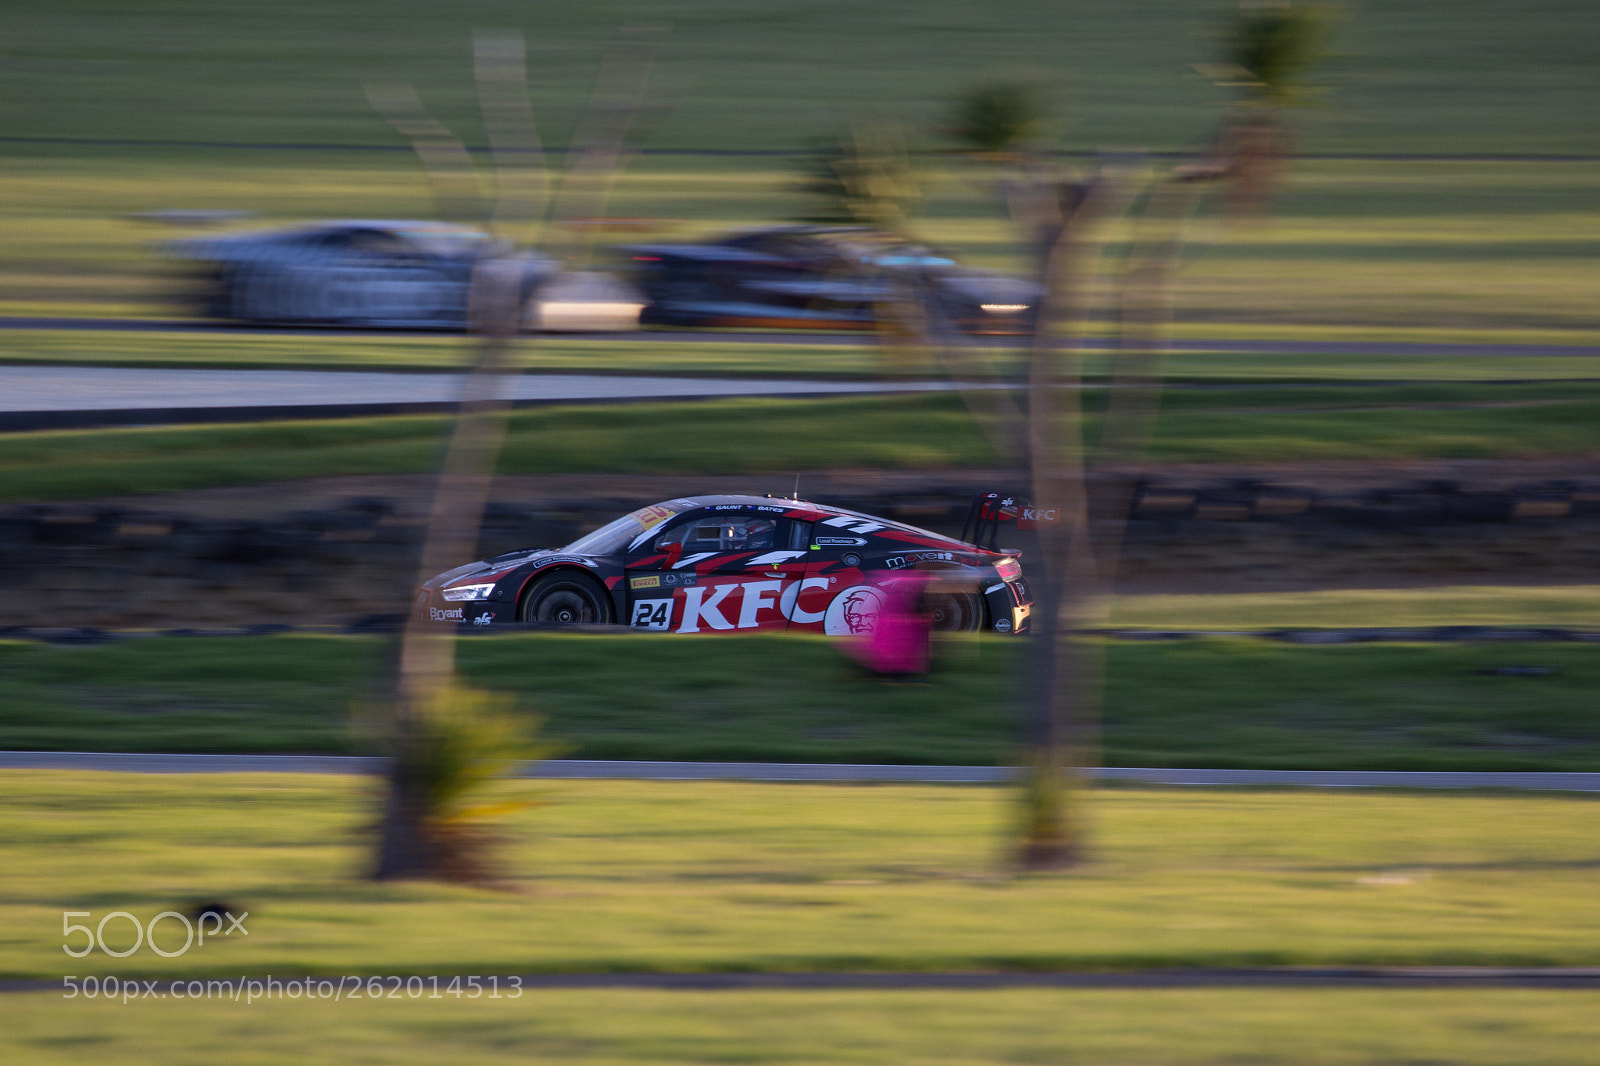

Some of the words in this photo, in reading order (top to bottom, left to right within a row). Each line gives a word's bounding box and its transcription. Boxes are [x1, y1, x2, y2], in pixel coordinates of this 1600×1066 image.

[757, 505, 784, 513] BATES
[1021, 509, 1056, 520] KFC
[675, 577, 829, 633] KFC
[430, 607, 463, 620] Bryant
[636, 602, 668, 627] 24
